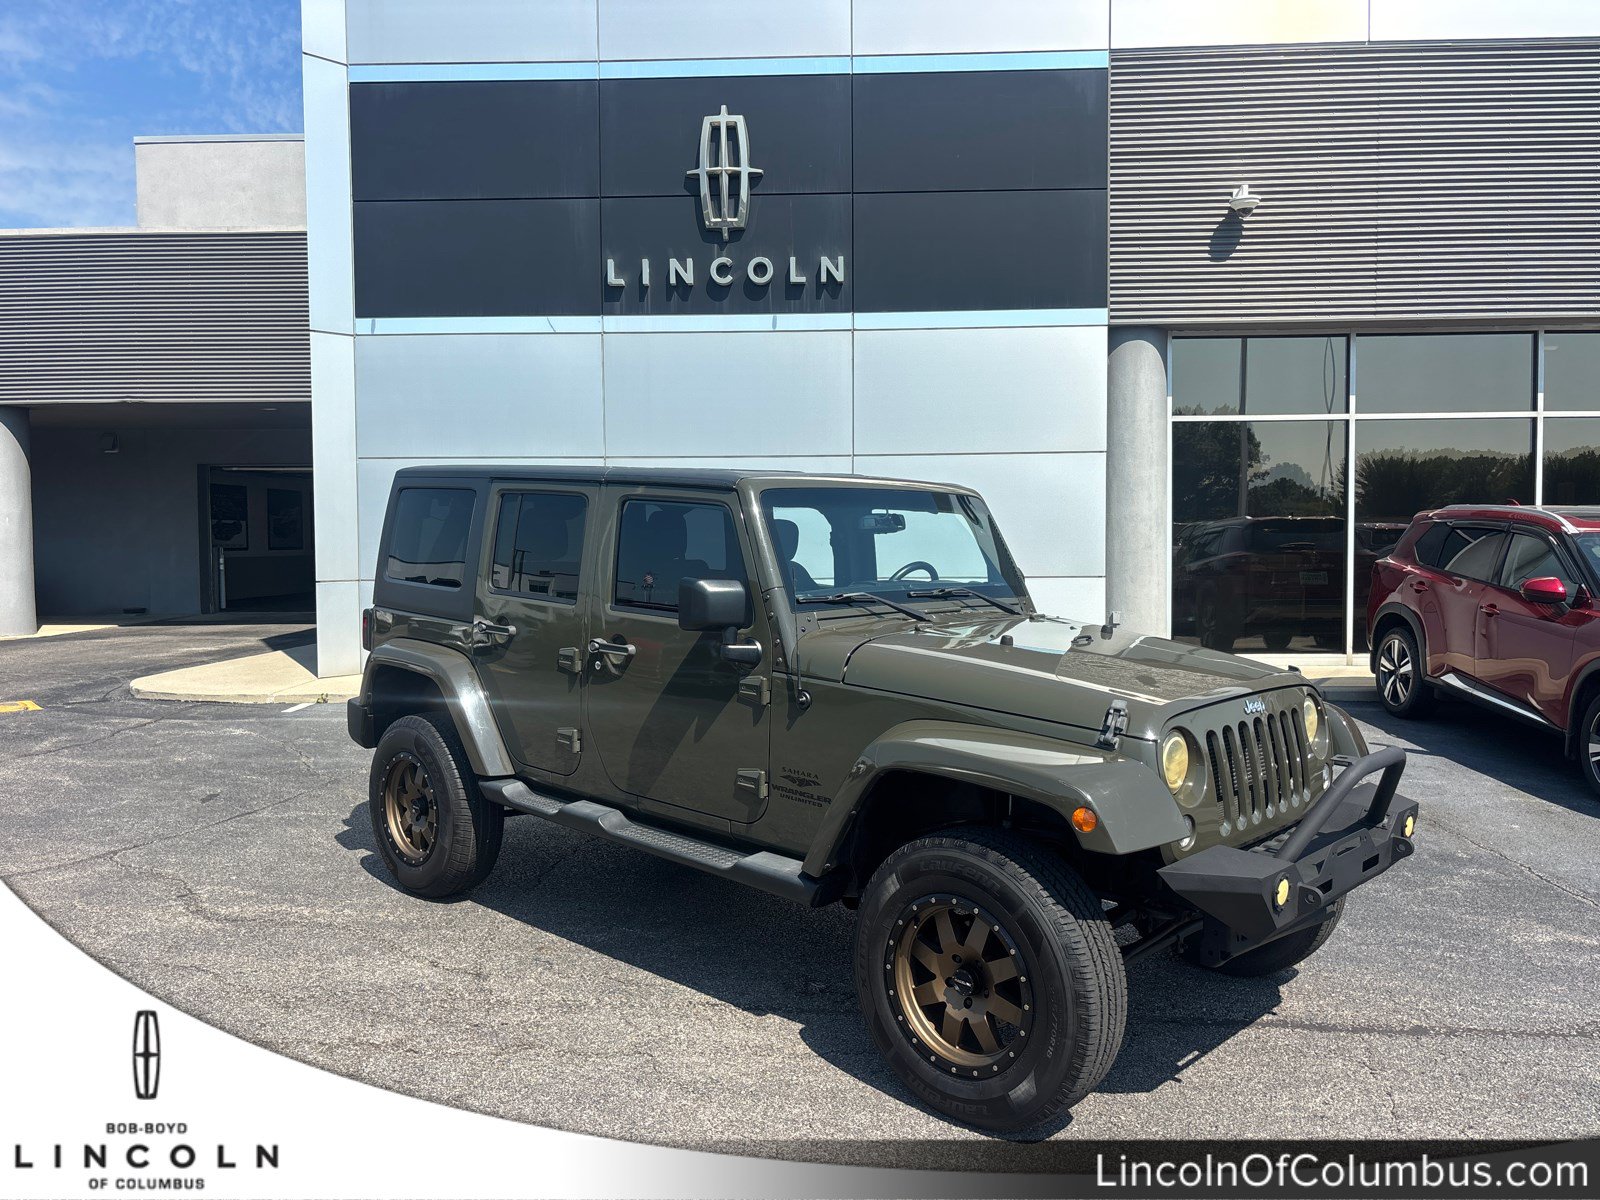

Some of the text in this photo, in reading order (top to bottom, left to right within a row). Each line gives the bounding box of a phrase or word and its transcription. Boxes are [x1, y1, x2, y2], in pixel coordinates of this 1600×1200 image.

[607, 256, 844, 285] LINCOLN
[1244, 699, 1266, 715] Jeep
[782, 766, 819, 780] SAHARA
[772, 783, 832, 805] WRANGLER
[780, 793, 823, 807] UNLIMITED
